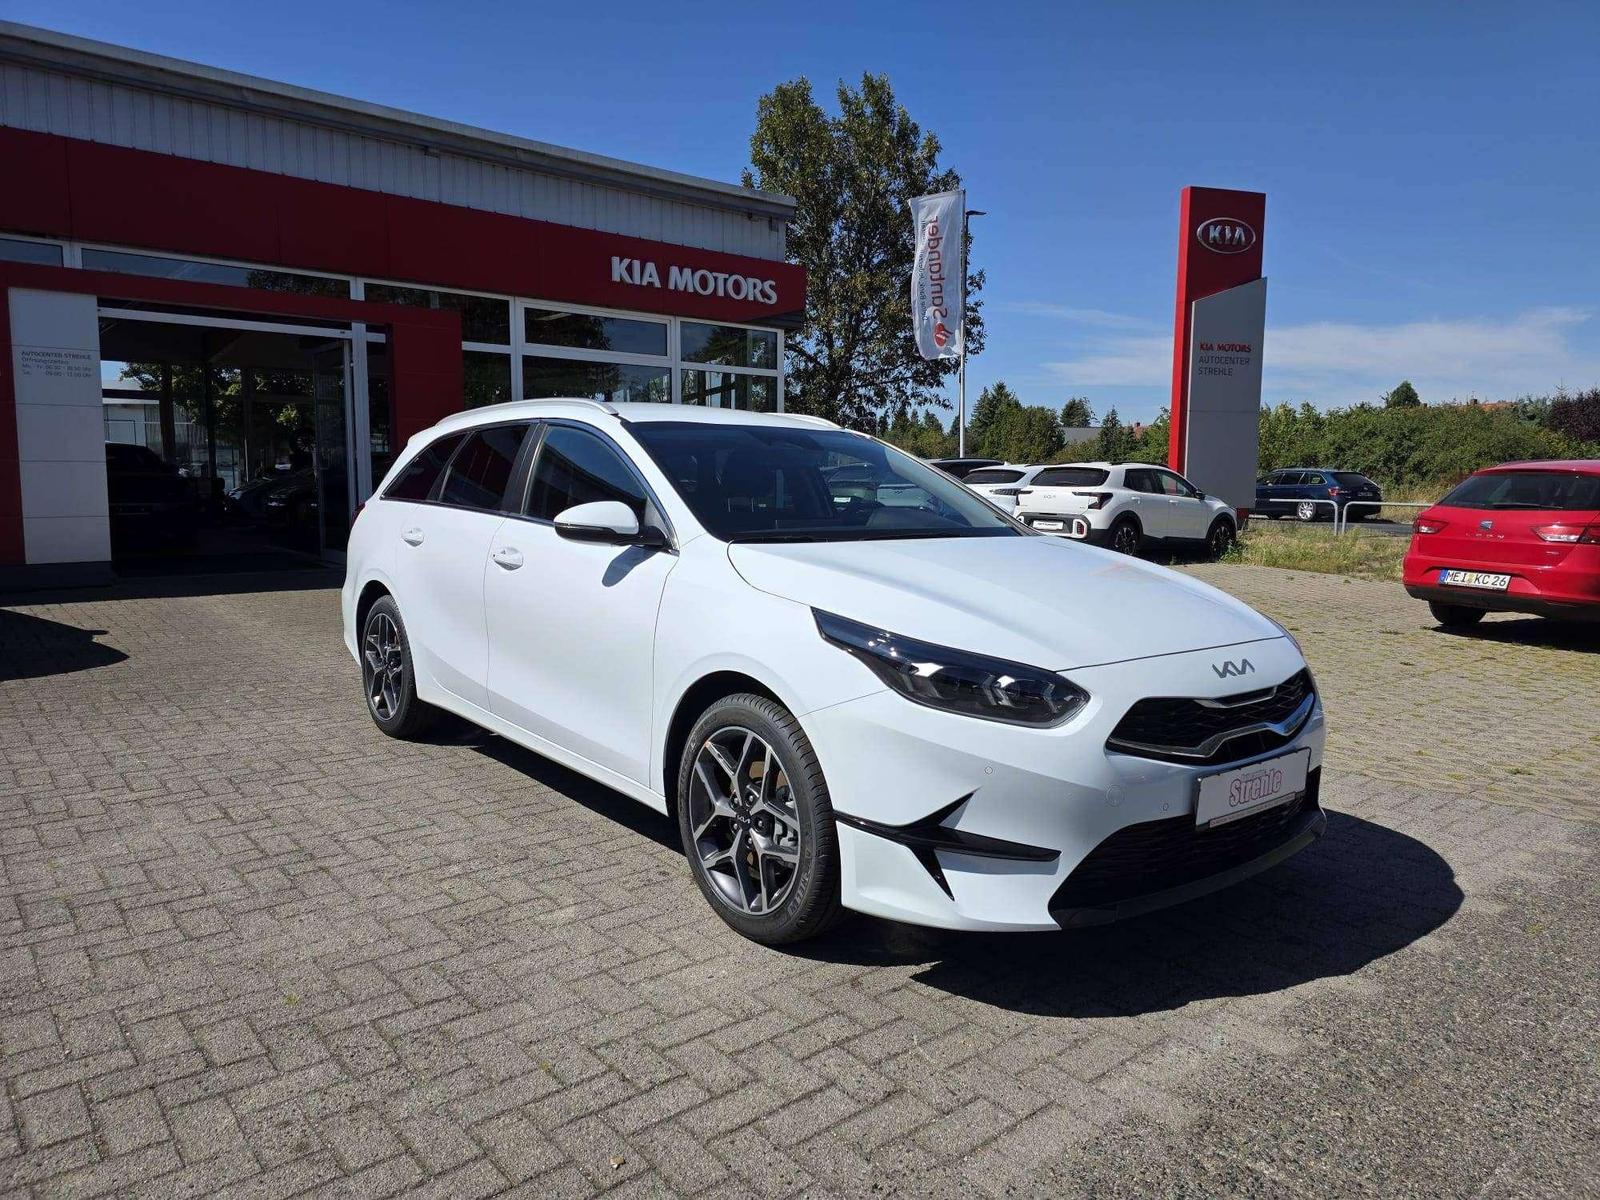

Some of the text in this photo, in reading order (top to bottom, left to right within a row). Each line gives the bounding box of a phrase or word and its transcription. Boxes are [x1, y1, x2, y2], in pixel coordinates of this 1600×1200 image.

[1209, 224, 1246, 245] KIA
[611, 256, 778, 305] KIA MOTORS
[1200, 343, 1252, 353] KIA MOTORS
[1198, 355, 1250, 366] AUTOCENTER
[1198, 366, 1233, 377] STREHLE
[1446, 569, 1507, 587] MEI KC 26
